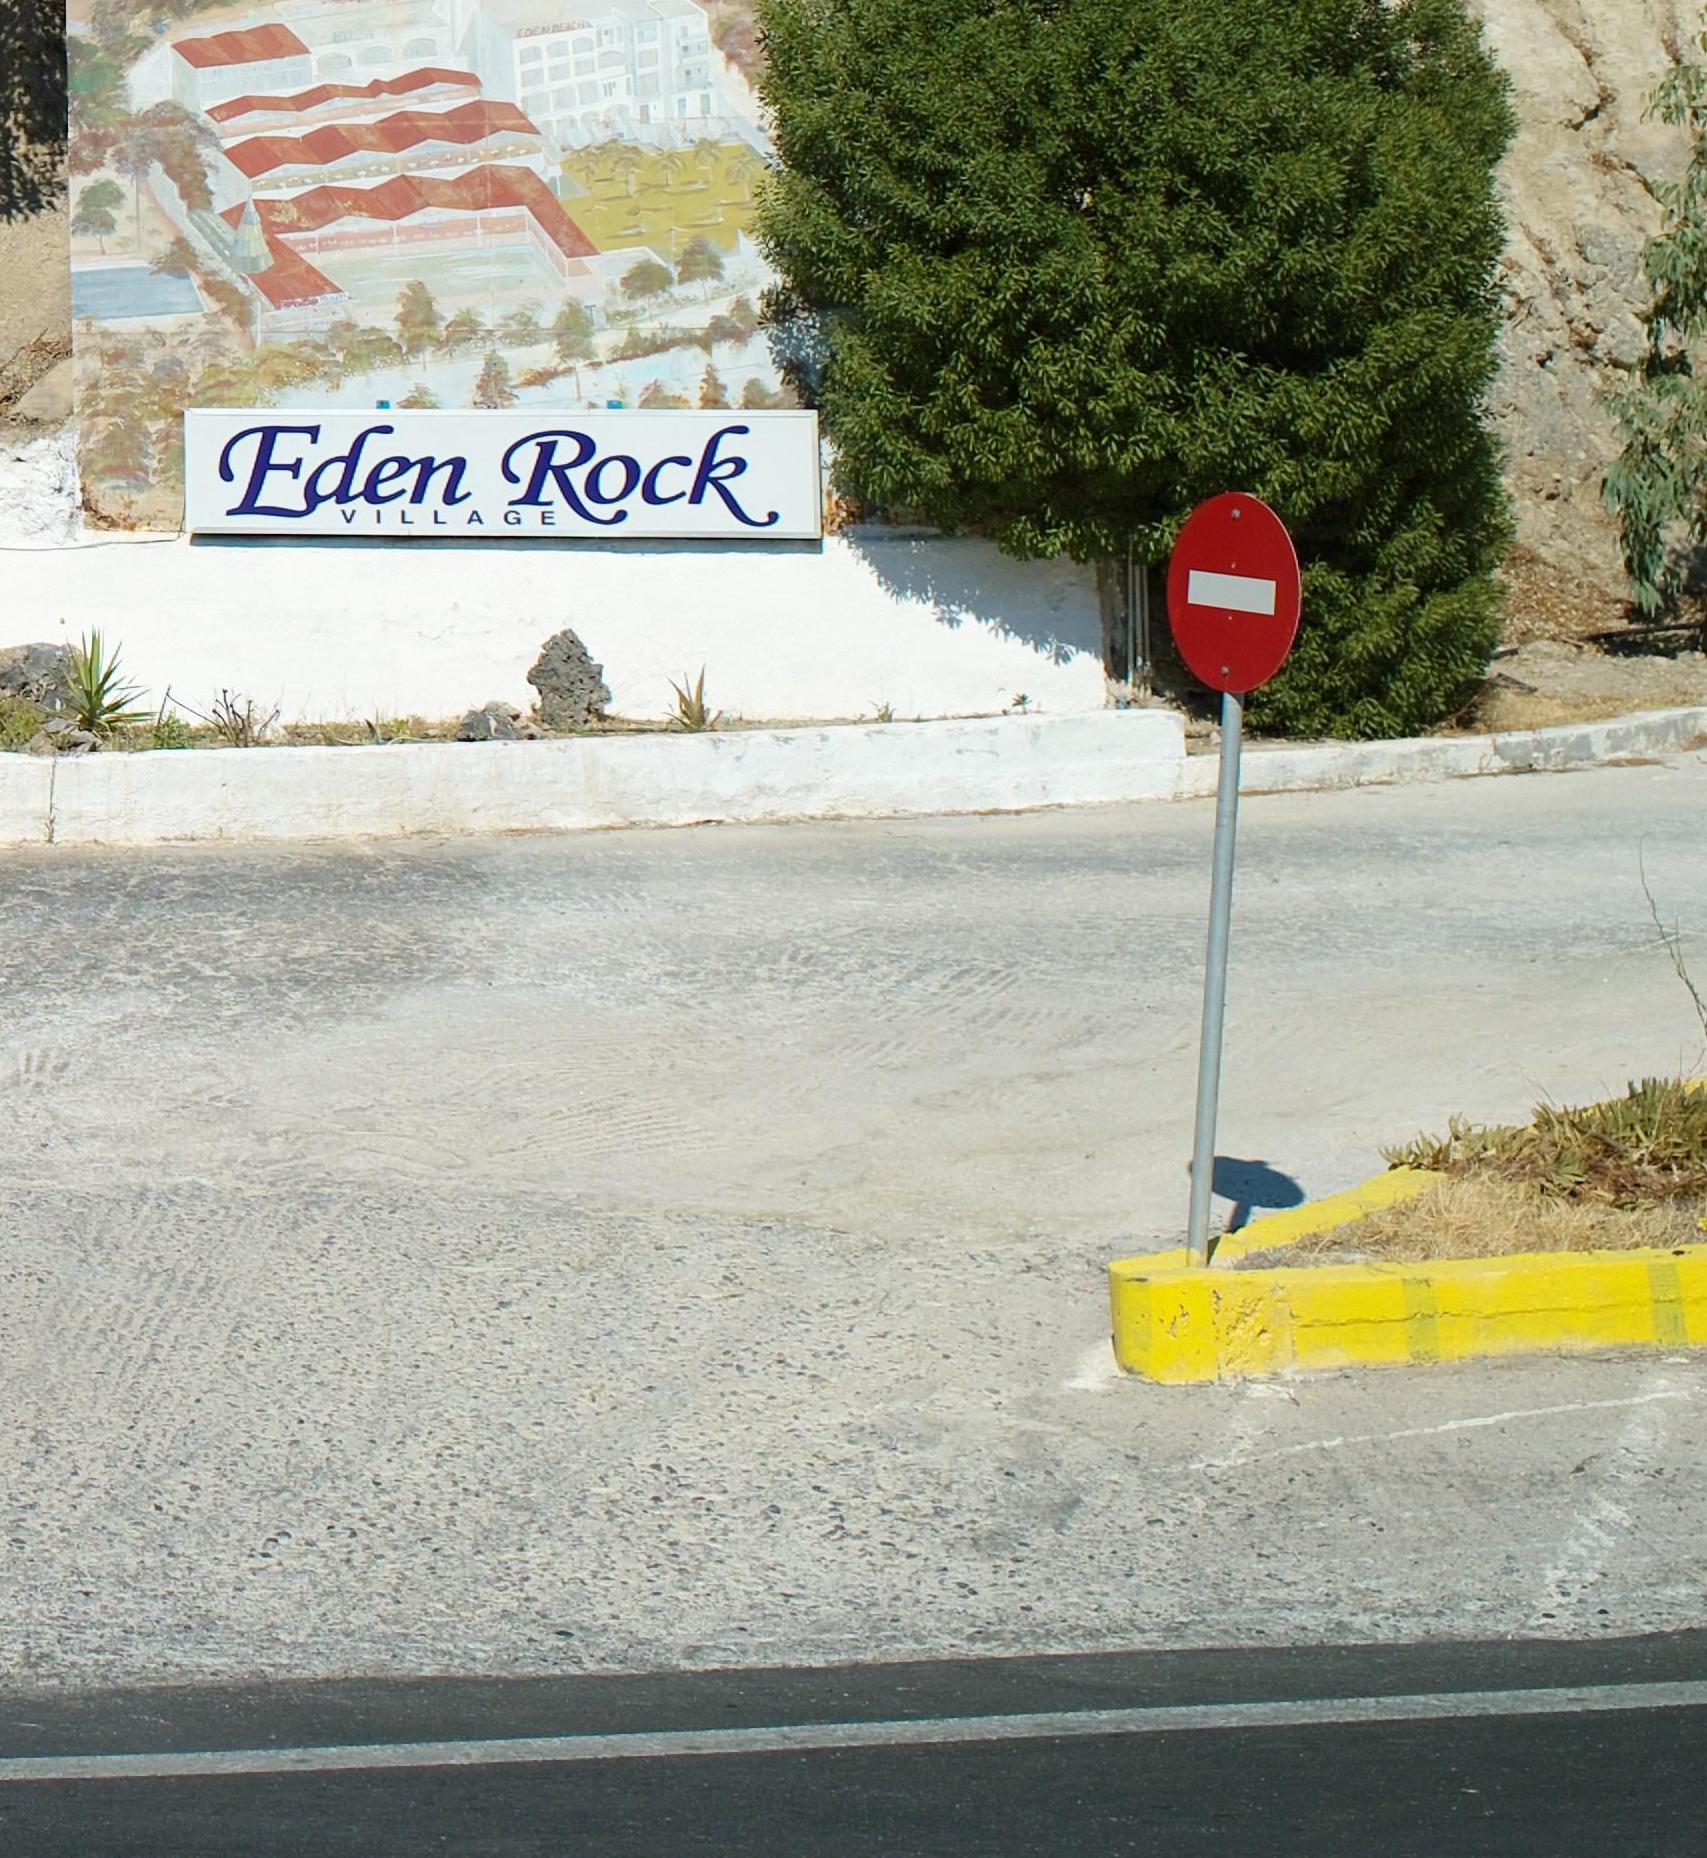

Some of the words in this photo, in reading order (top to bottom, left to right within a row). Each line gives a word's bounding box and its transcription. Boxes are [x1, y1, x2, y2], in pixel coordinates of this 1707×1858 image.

[219, 424, 472, 517] Eden
[501, 424, 779, 527] Rock
[340, 509, 557, 525] VILLAGE
